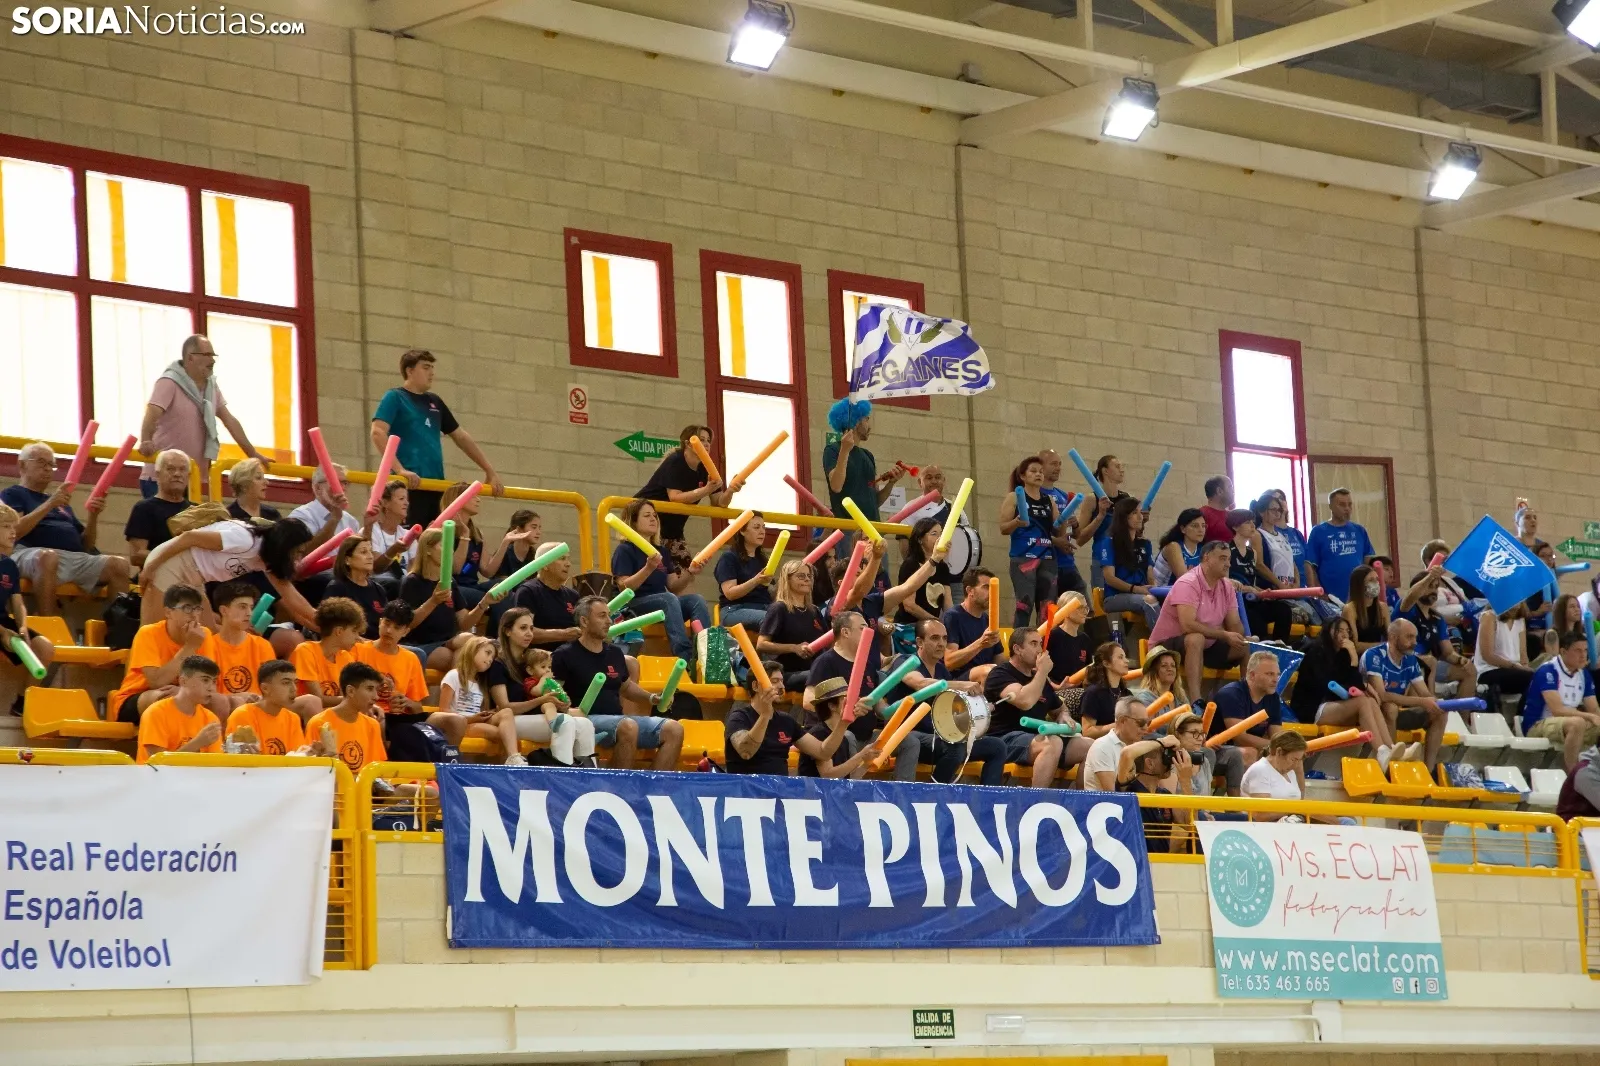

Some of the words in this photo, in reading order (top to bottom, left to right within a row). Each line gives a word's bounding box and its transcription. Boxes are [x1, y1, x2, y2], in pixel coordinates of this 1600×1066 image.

[424, 417, 431, 428] 4
[628, 439, 655, 454] SALIDA
[6, 840, 74, 871] Real
[84, 842, 238, 872] Federación
[462, 786, 839, 910] MONTE
[854, 801, 1138, 909] PINOS
[1273, 839, 1326, 879] Ms.
[4, 889, 143, 928] Española
[1, 939, 38, 970] de
[48, 938, 171, 969] Voleibol
[1217, 945, 1439, 974] www.mseclat.com
[1221, 973, 1243, 990] Tel:
[1246, 974, 1271, 991] 635
[1276, 975, 1301, 992] 463
[1306, 976, 1330, 992] 665
[914, 1025, 954, 1037] EMERGENCIA
[915, 1012, 940, 1023] SALIDA
[942, 1012, 952, 1023] DE
